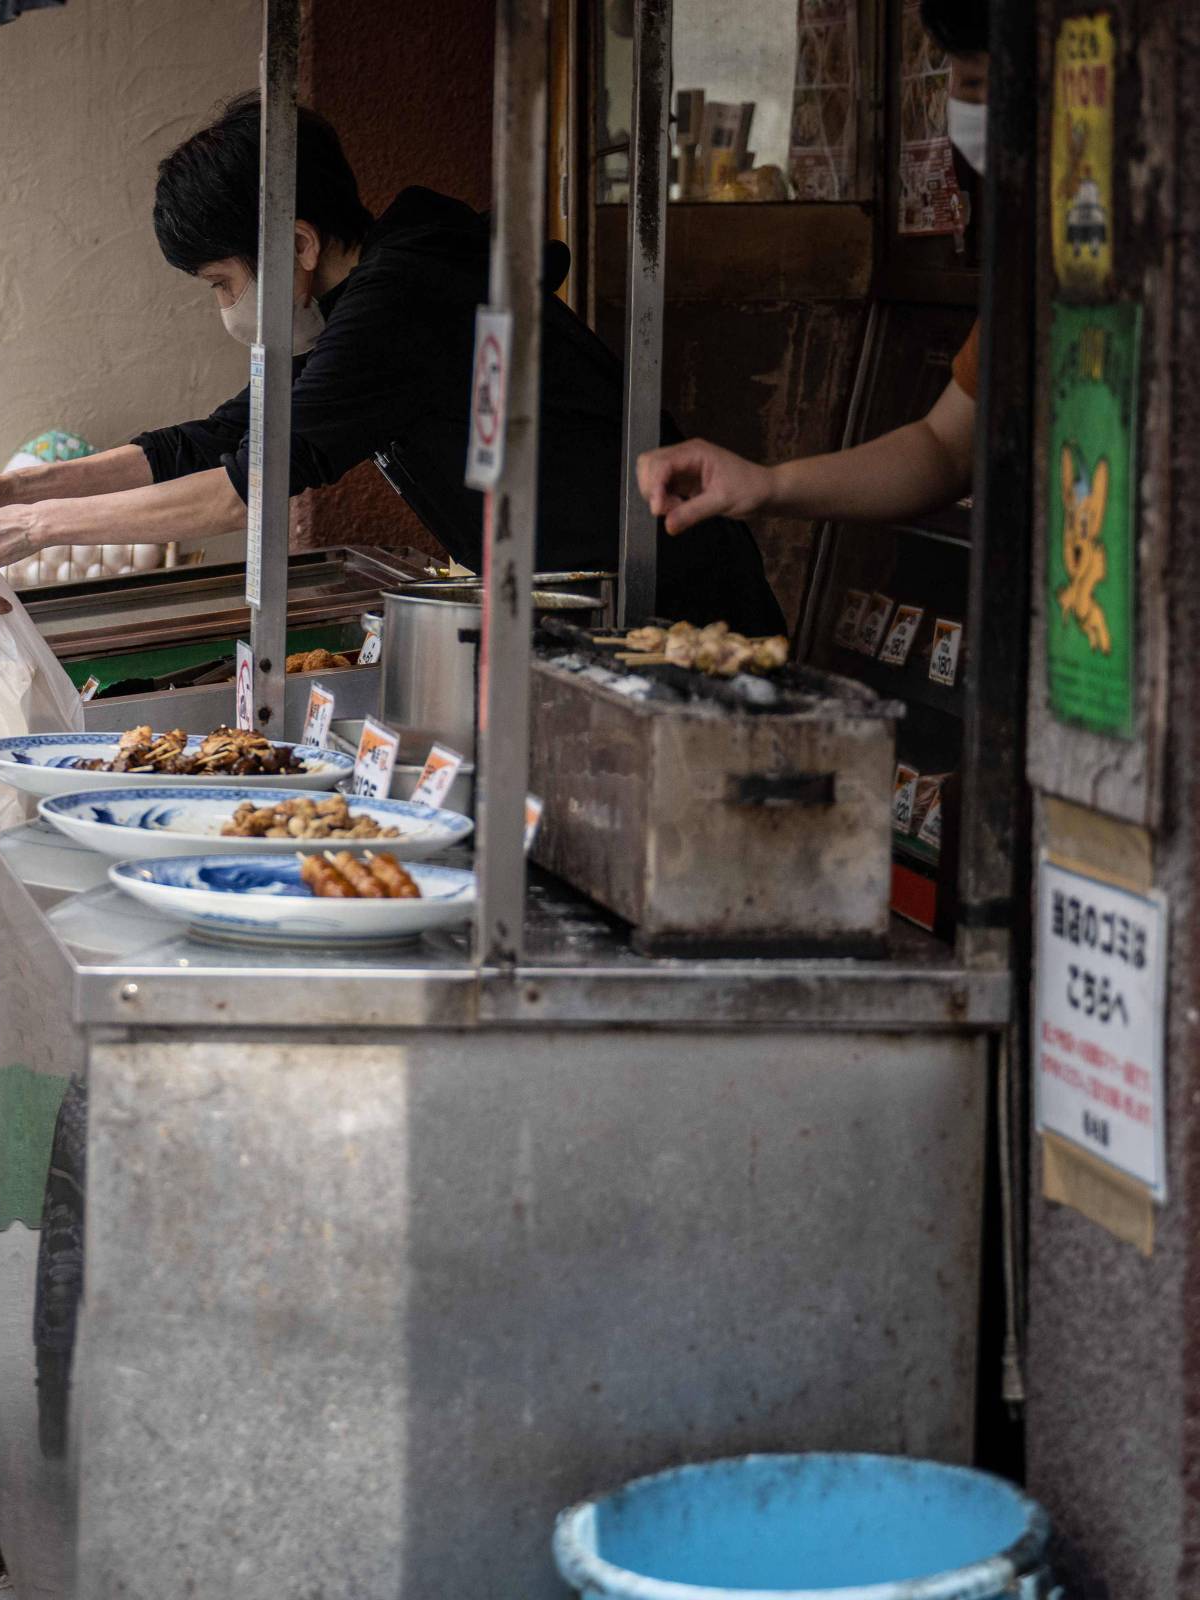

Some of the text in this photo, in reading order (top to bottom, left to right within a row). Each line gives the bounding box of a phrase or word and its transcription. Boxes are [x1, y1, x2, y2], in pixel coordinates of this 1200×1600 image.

[937, 654, 953, 677] 180
[1066, 963, 1129, 1029] こちらへ
